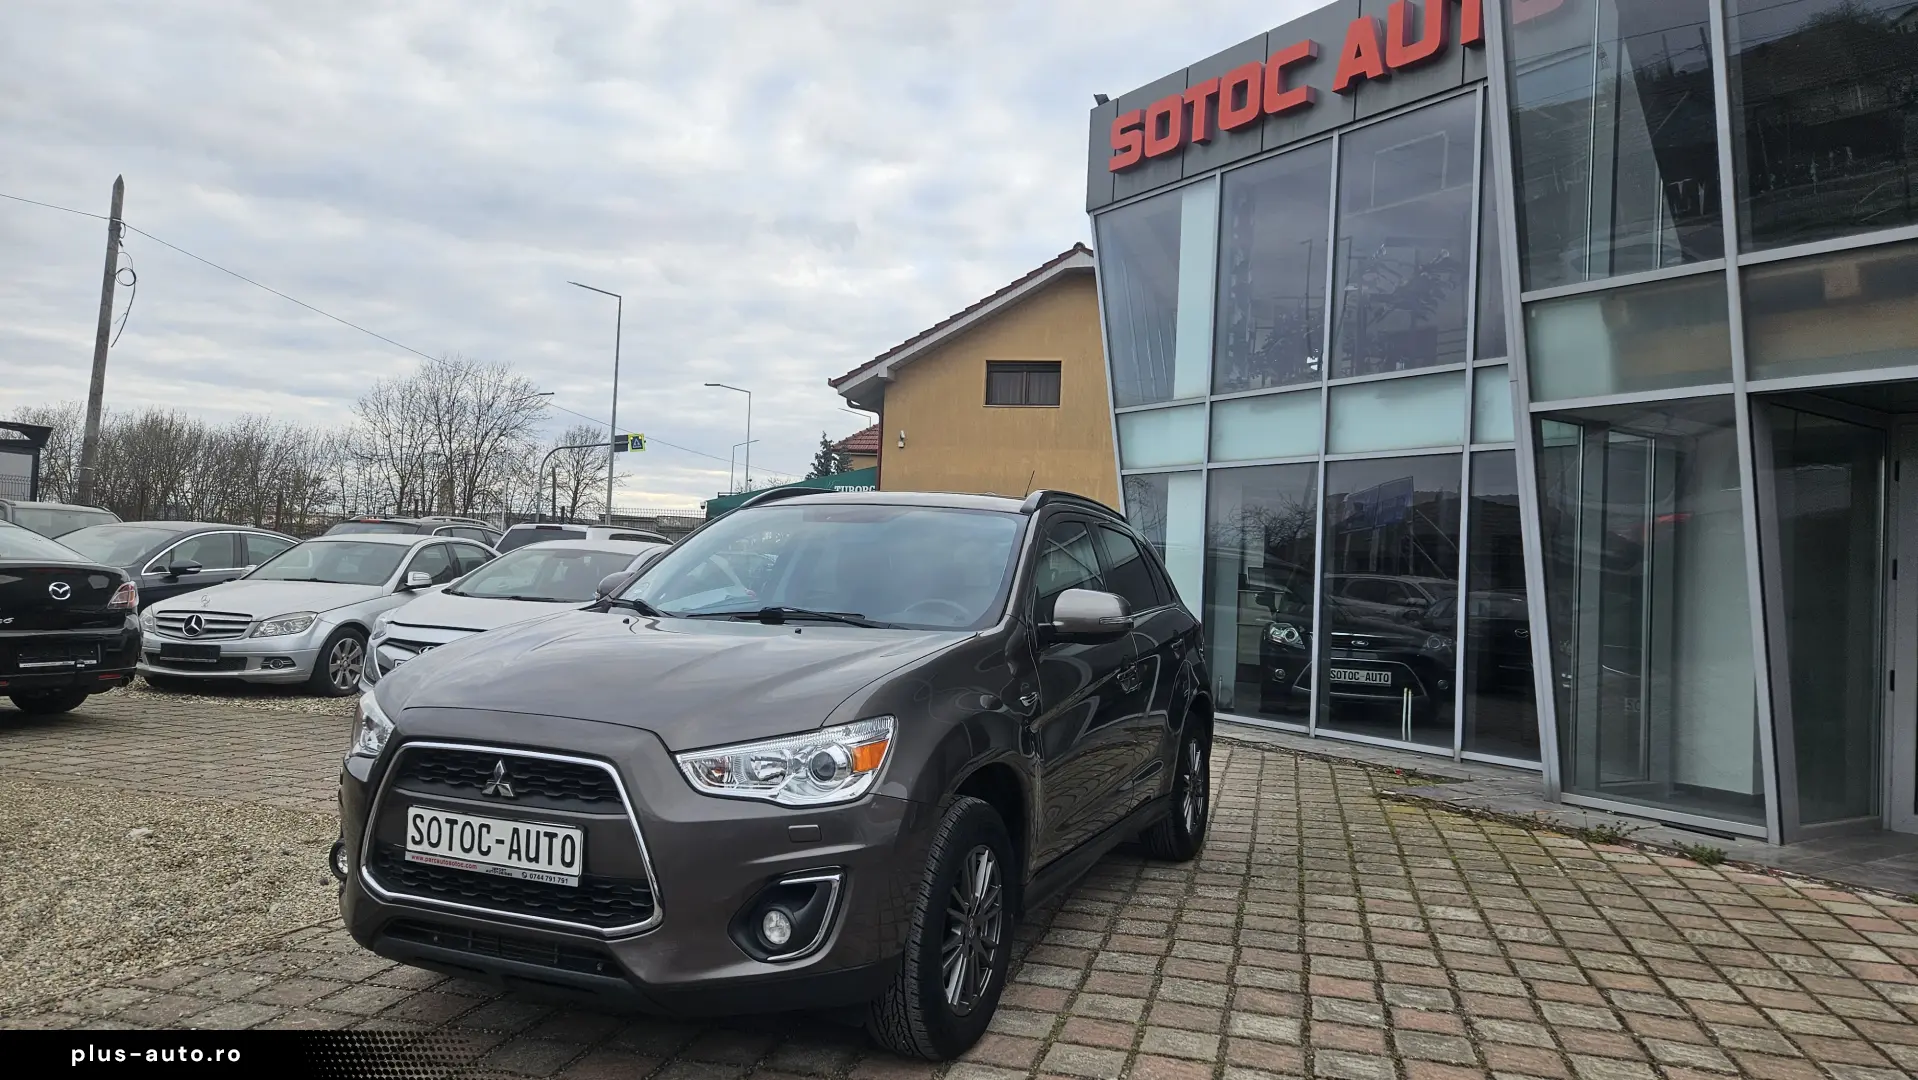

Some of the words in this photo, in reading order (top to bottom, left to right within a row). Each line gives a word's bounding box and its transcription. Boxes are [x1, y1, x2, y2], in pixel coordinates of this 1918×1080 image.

[1109, 39, 1318, 173] SOTOC
[1332, 0, 1564, 94] AUT
[1330, 670, 1389, 683] SOTOC-AUTO
[411, 813, 576, 868] SOTOC-AUTO
[411, 855, 478, 870] www.parcautosotoc.com
